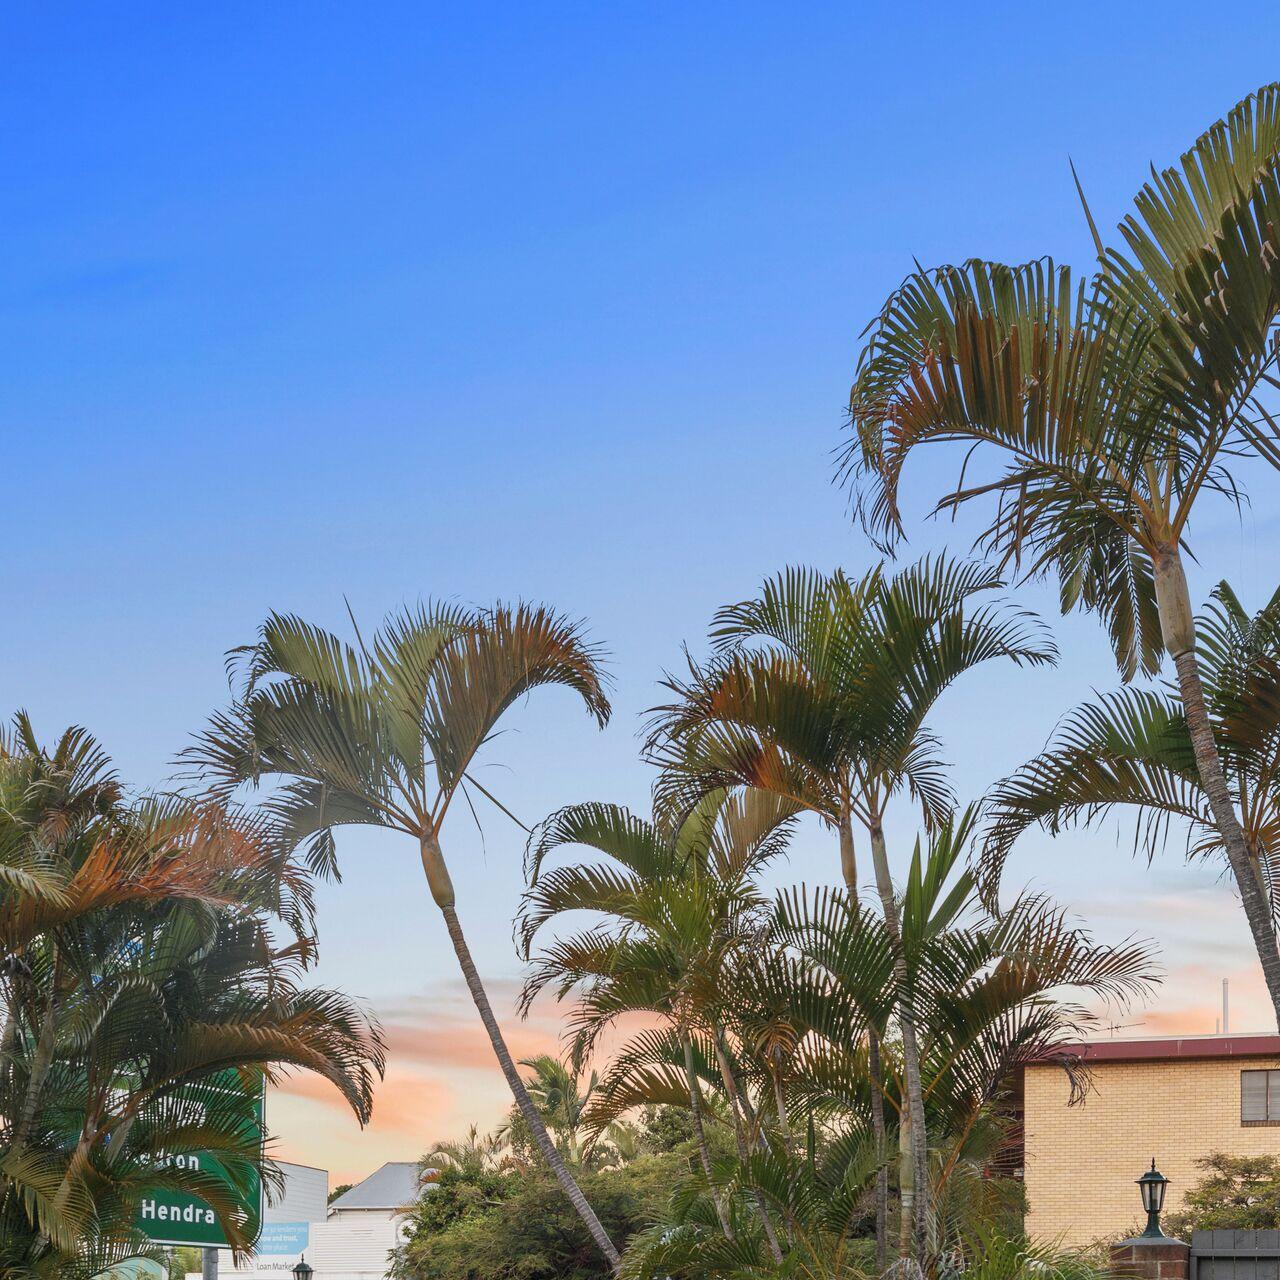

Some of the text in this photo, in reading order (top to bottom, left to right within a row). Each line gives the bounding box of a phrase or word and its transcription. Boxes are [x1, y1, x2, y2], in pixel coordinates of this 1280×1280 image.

[141, 1199, 215, 1224] Hendra
[256, 1261, 294, 1271] Loan Market
